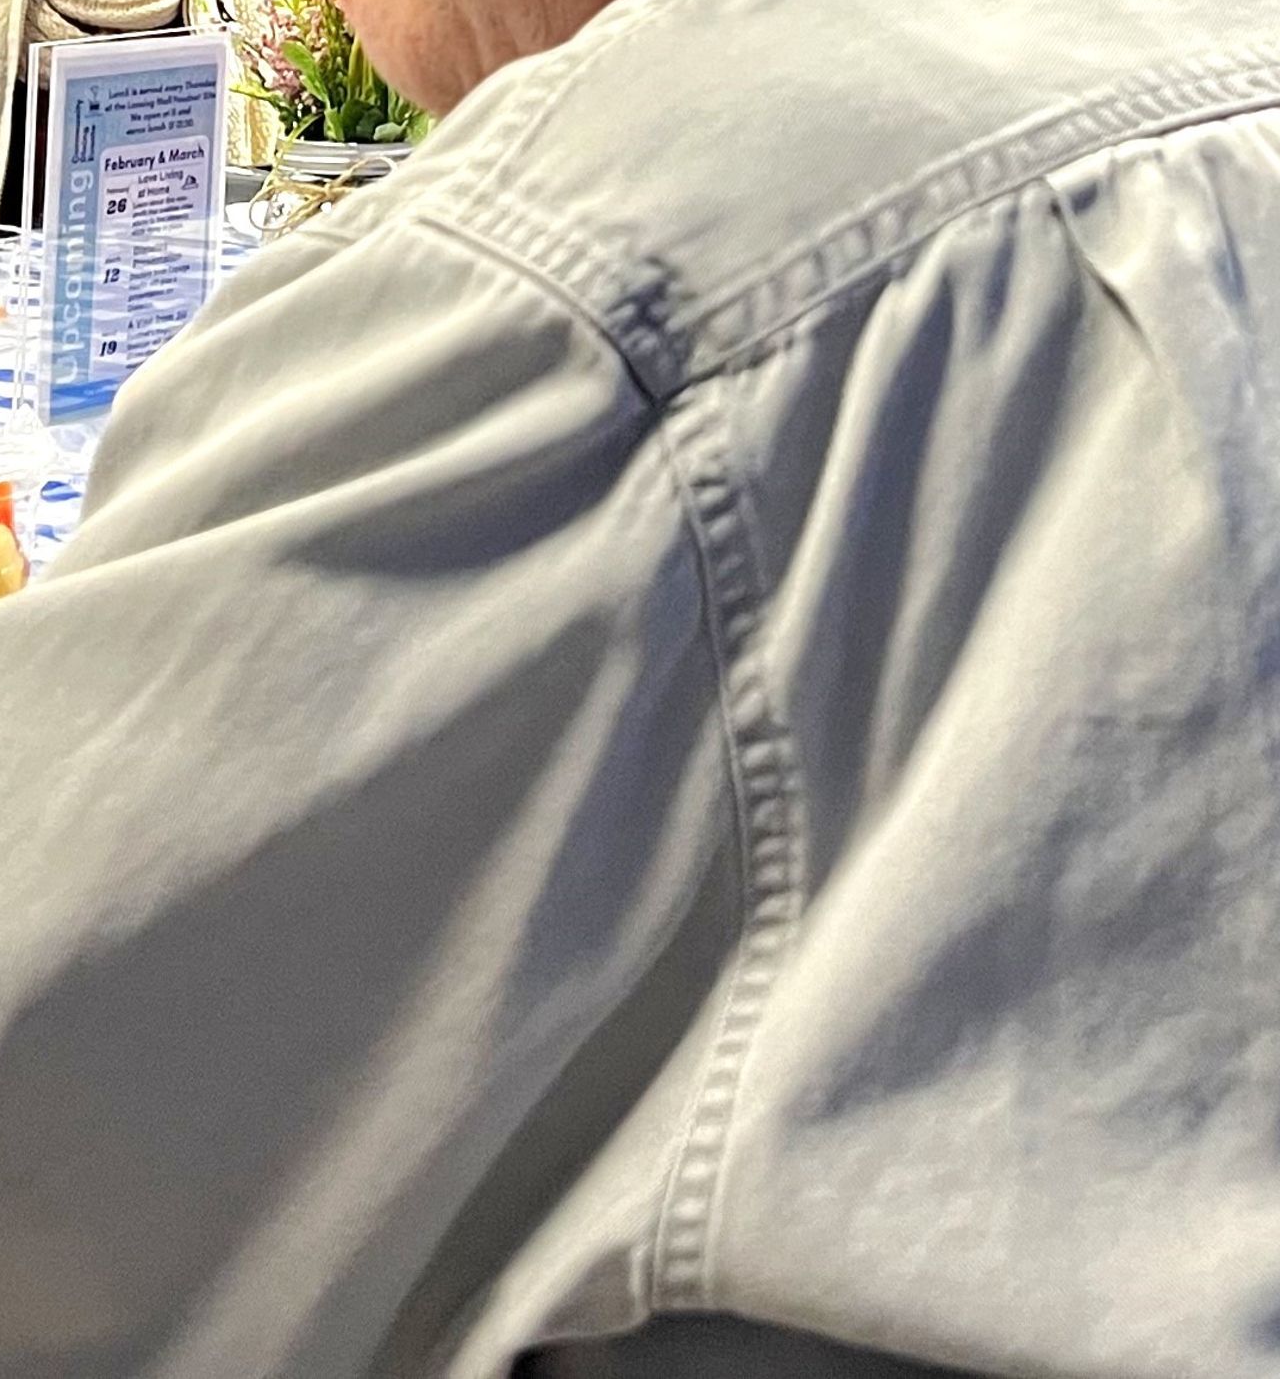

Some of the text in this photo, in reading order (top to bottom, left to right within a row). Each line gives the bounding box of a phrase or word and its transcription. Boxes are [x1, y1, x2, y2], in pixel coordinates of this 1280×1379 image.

[104, 145, 205, 172] February & March
[106, 198, 127, 215] 26
[56, 169, 94, 384] Upcoming
[103, 267, 121, 284] 12
[99, 340, 118, 357] 19
